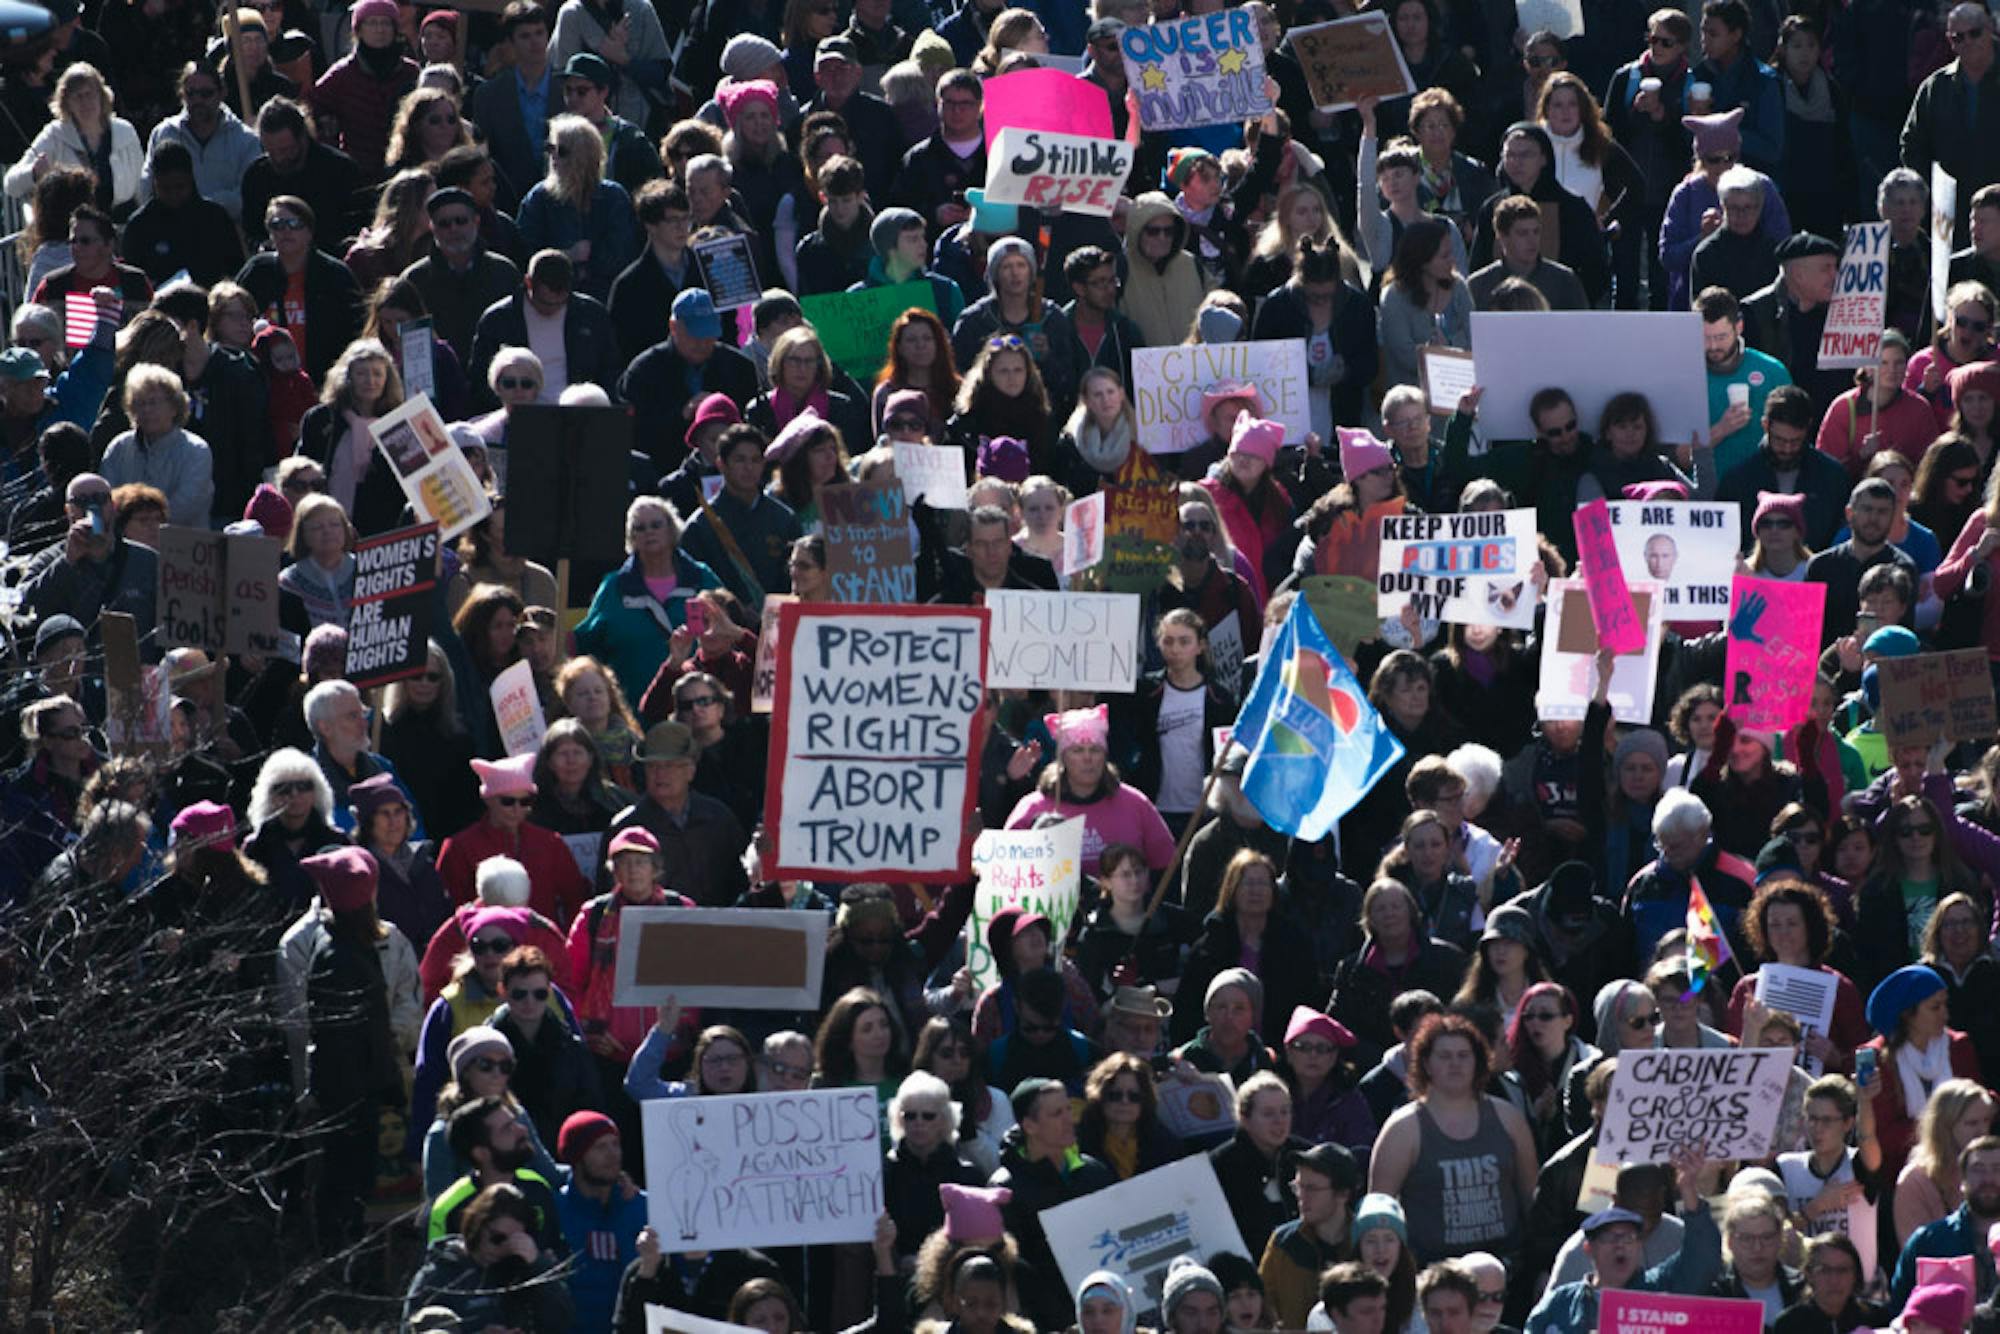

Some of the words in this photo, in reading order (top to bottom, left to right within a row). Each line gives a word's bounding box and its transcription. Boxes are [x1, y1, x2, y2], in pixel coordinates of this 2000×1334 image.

[1122, 10, 1254, 63] QUEER
[1835, 260, 1884, 294] YOUR
[1828, 295, 1881, 328] TAXES
[1161, 346, 1260, 384] CIVIL
[1383, 516, 1442, 541] KEEP
[1450, 513, 1507, 539] YOUR
[1641, 507, 1675, 526] ARE
[1690, 510, 1725, 528] NOT
[357, 533, 437, 574] WOMEN'S
[1402, 543, 1516, 571] POLITICS
[235, 578, 268, 603] as
[354, 563, 417, 600] RIGHTS
[1380, 571, 1429, 594] OUT
[1437, 576, 1467, 599] OF
[1686, 585, 1729, 605] THIS
[350, 600, 384, 629] ARE
[998, 594, 1121, 636] TRUST
[1410, 591, 1449, 620] MY
[348, 614, 412, 651] HUMAN
[816, 625, 975, 671] PROTECT
[345, 639, 408, 675] RIGHTS
[988, 639, 1132, 686] WOMEN
[804, 673, 982, 713] WOMEN'S
[807, 712, 962, 756] RIGHTS
[808, 762, 965, 813] ABORT
[799, 817, 941, 865] TRUMP
[972, 833, 1056, 863] Women's
[991, 863, 1045, 903] Rights
[1632, 1053, 1770, 1086] CABINET
[733, 1093, 876, 1148] PUSSIES
[1628, 1091, 1751, 1120] CROOKS
[1628, 1119, 1749, 1142] BIGOTS
[739, 1145, 845, 1177] AGAINST
[1438, 1154, 1500, 1189] THIS
[713, 1170, 882, 1229] PATRIARCHY
[1617, 1307, 1625, 1321] I
[1628, 1307, 1689, 1325] STAND
